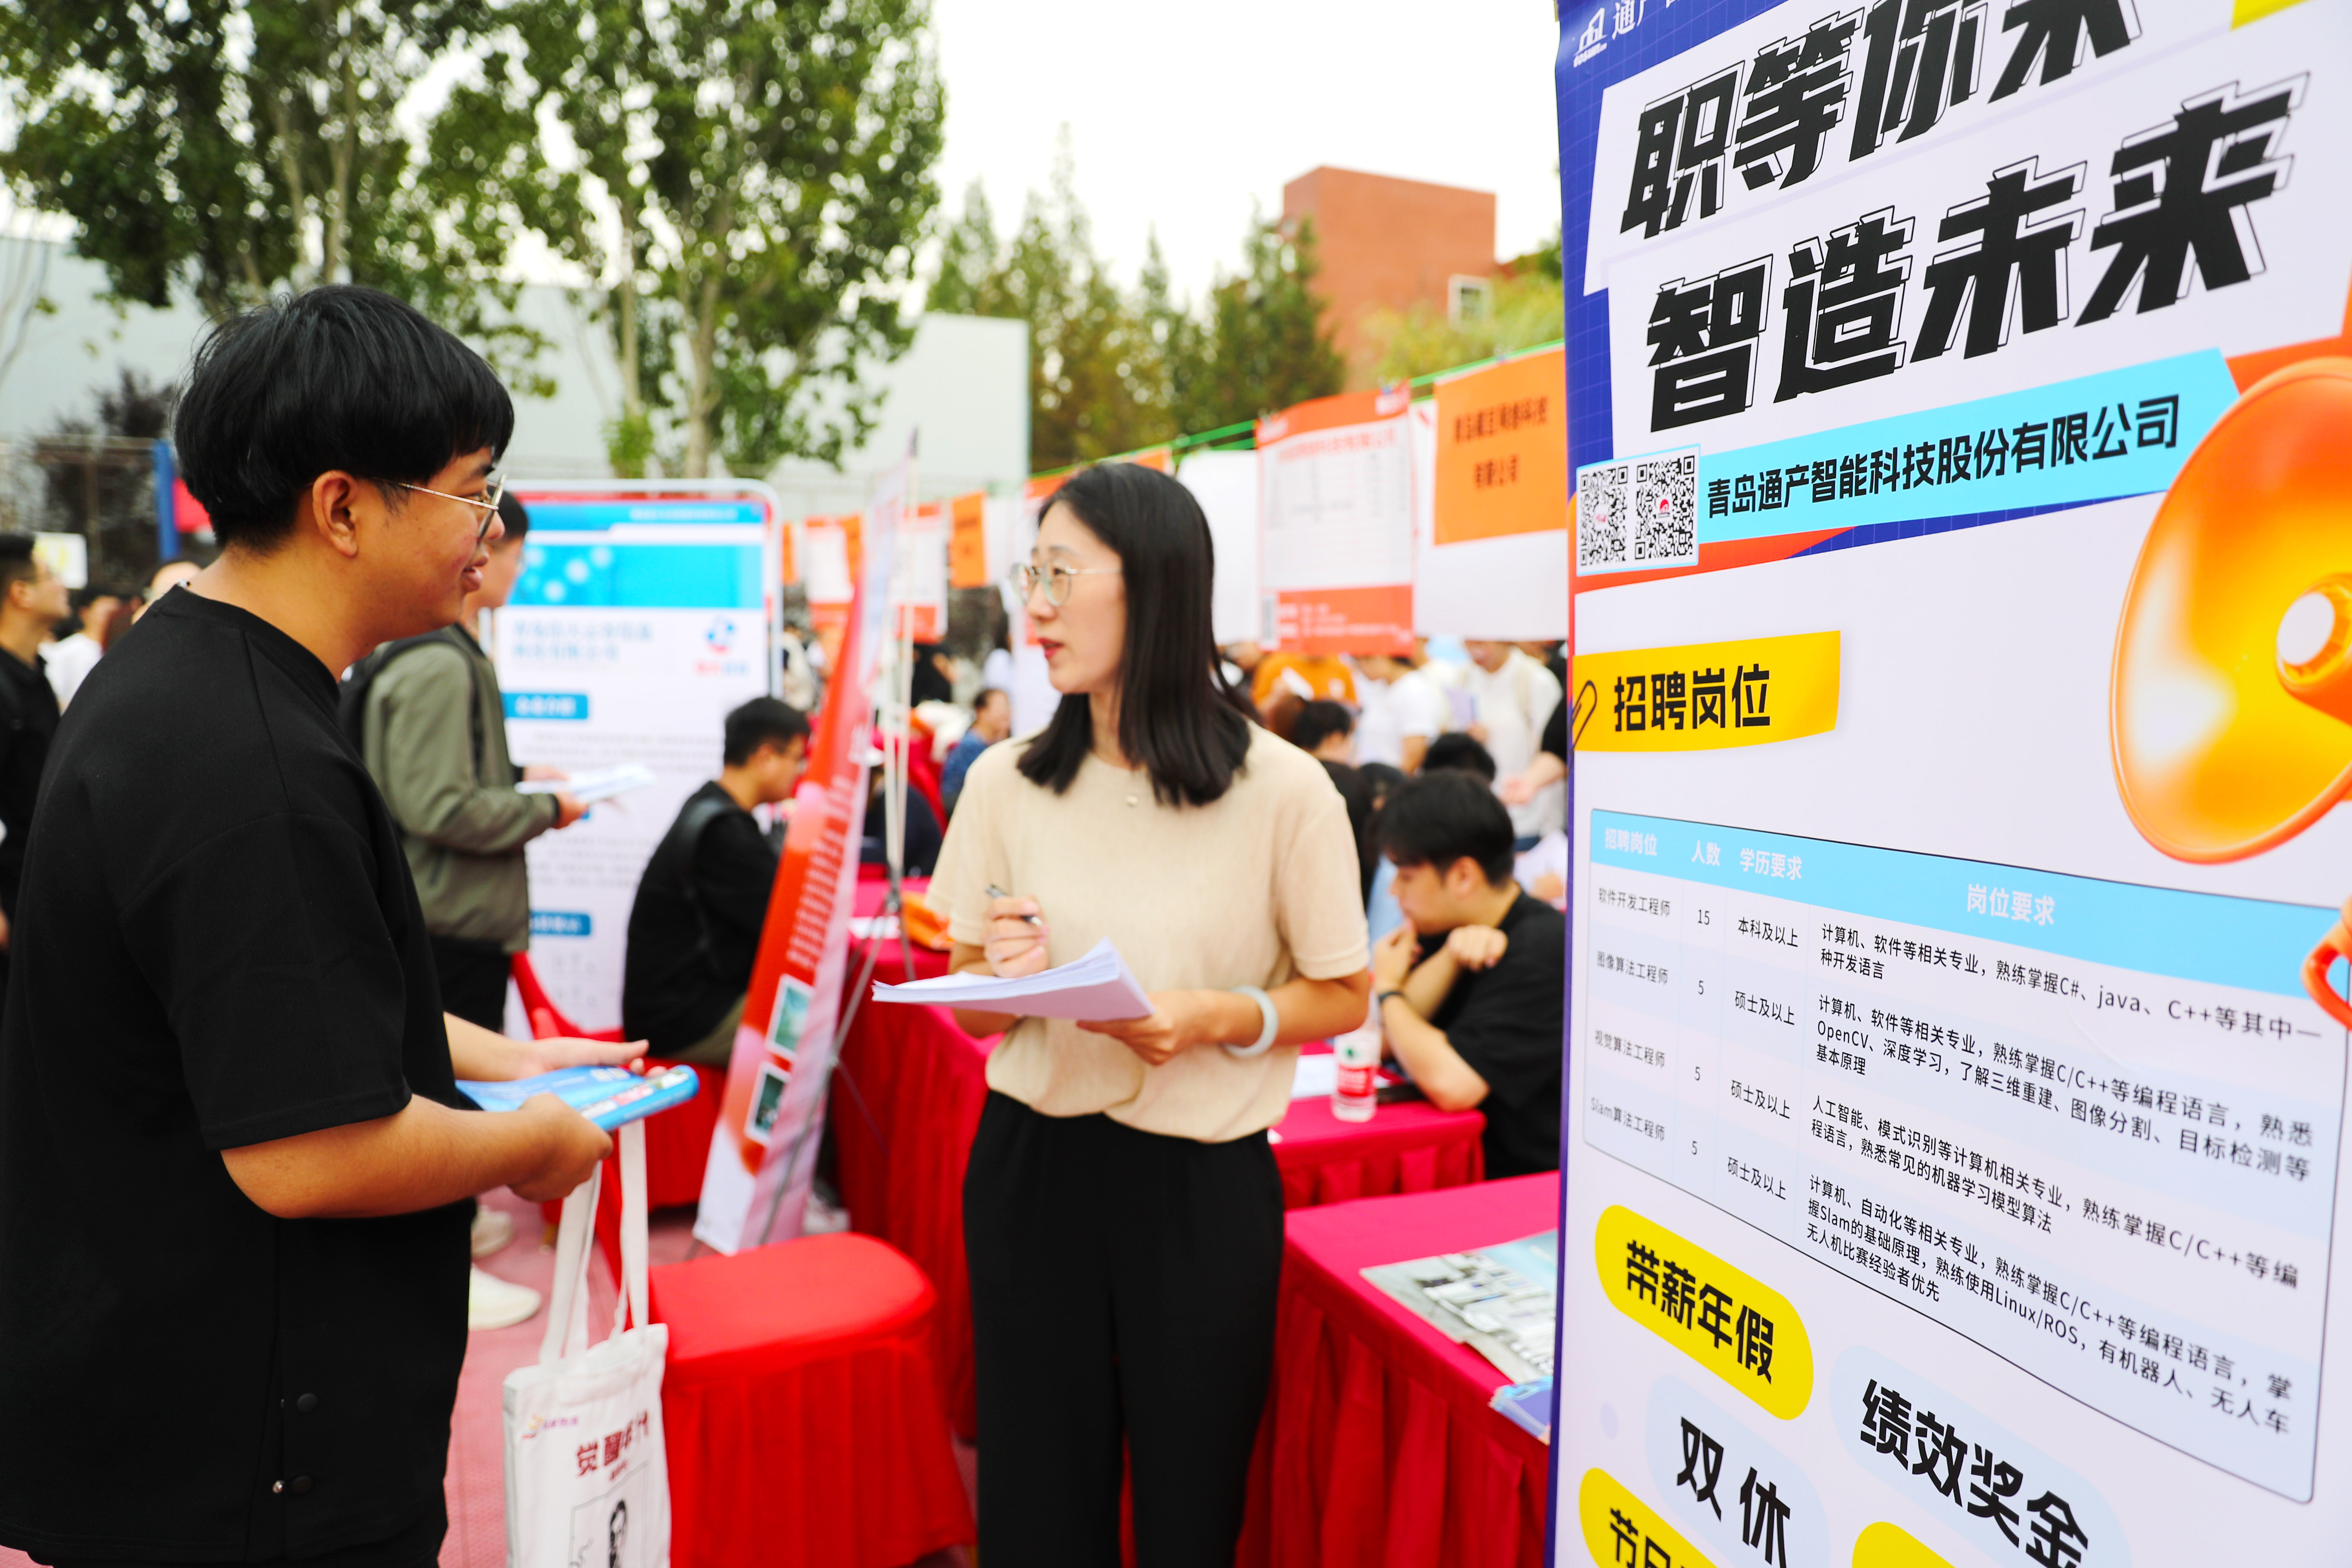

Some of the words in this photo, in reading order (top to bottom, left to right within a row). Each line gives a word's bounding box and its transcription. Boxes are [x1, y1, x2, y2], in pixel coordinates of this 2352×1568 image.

[1647, 71, 2311, 433] 智造未来
[1708, 394, 2180, 518] 青岛通产智能科技股份有限公司
[1614, 662, 1771, 732] 招聘岗位
[1605, 827, 1657, 856] 招聘岗位
[1691, 840, 1721, 866] 人数
[1740, 848, 1802, 880] 学历要求
[1598, 887, 1670, 917] 软件开发工程师
[1698, 909, 1710, 925] 15
[1967, 883, 2055, 925] 岗位要求
[1738, 916, 1798, 947] 本科及以上
[1596, 950, 1669, 985] 图像算法工程师
[1821, 948, 1885, 980] 种开发语言
[1821, 924, 2321, 1040] 计算机、软件等相关专业，熟练掌握C#、java、C++等其中一
[1698, 981, 1704, 995] 5
[1735, 991, 1795, 1026] 硕士及以上
[1595, 1030, 1666, 1068] 视觉算法工程师
[1816, 1043, 1866, 1075] 基本原理
[1694, 1066, 1700, 1081] 5
[1819, 994, 2313, 1148] 计算机、软件等相关专业，熟练掌握C/C++等编程语言，熟悉
[1590, 1097, 1666, 1142] Slam算法工程师
[1731, 1080, 1791, 1119] 硕士及以上
[1818, 1021, 2311, 1182] OpenCV、深度学习，了解三维重建、图像分割、目标检测等
[1692, 1141, 1698, 1155] 5
[1728, 1157, 1786, 1200] 硕士及以上
[1811, 1119, 2052, 1234] 程语言，熟悉常见的机器学习模型算法
[1813, 1095, 2298, 1289] 人工智能、模式识别等计算机相关专业，熟练掌握C/C++等编
[1807, 1222, 1940, 1302] 无人机比赛经验者优先
[1810, 1175, 2291, 1400] 计算机、自动化等相关专业，熟练掌握C/C++等编程语言，掌
[1625, 1240, 1774, 1384] 带薪年假
[1808, 1198, 2289, 1434] 握Slam的基础原理，熟练使用Linux/ROS，有机器人、无人车
[1860, 1378, 2089, 1568] 绩效奖金
[1610, 1507, 1686, 1568] 节日
